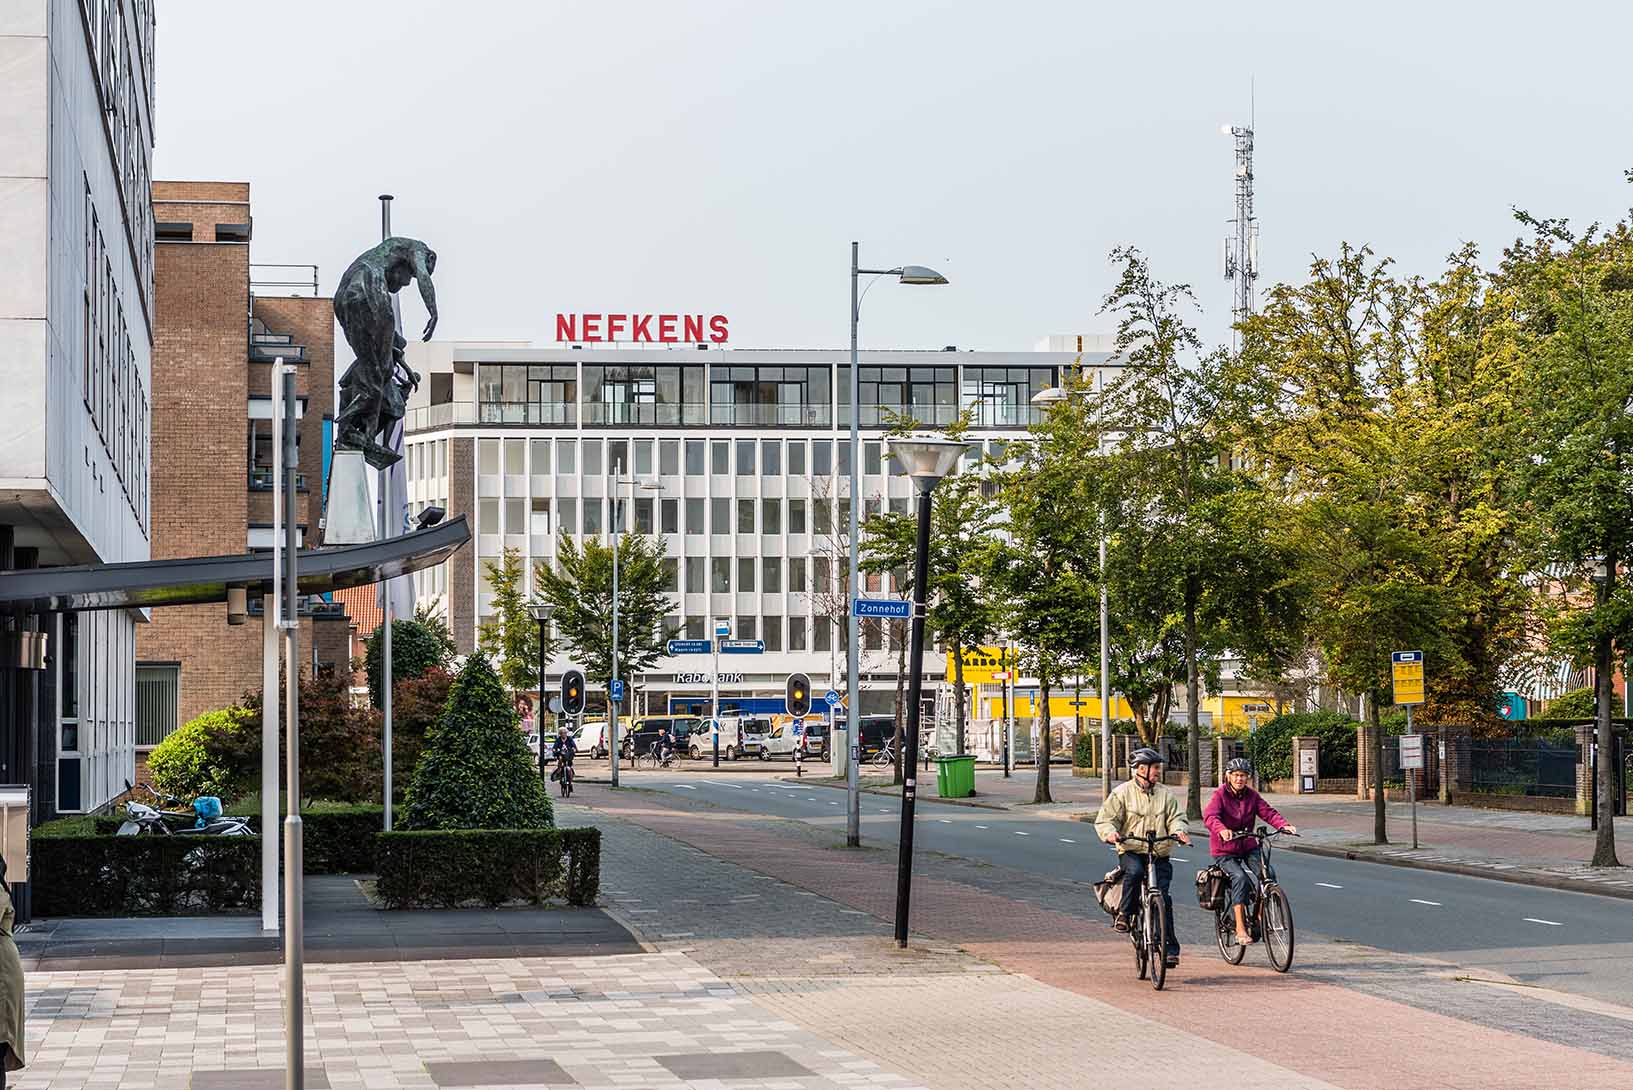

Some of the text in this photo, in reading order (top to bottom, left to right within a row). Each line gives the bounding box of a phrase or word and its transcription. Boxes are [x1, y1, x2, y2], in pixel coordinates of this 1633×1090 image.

[556, 313, 729, 343] NEFKENS
[860, 603, 905, 614] Zonnehof
[676, 671, 742, 683] Raboank
[613, 682, 621, 692] P
